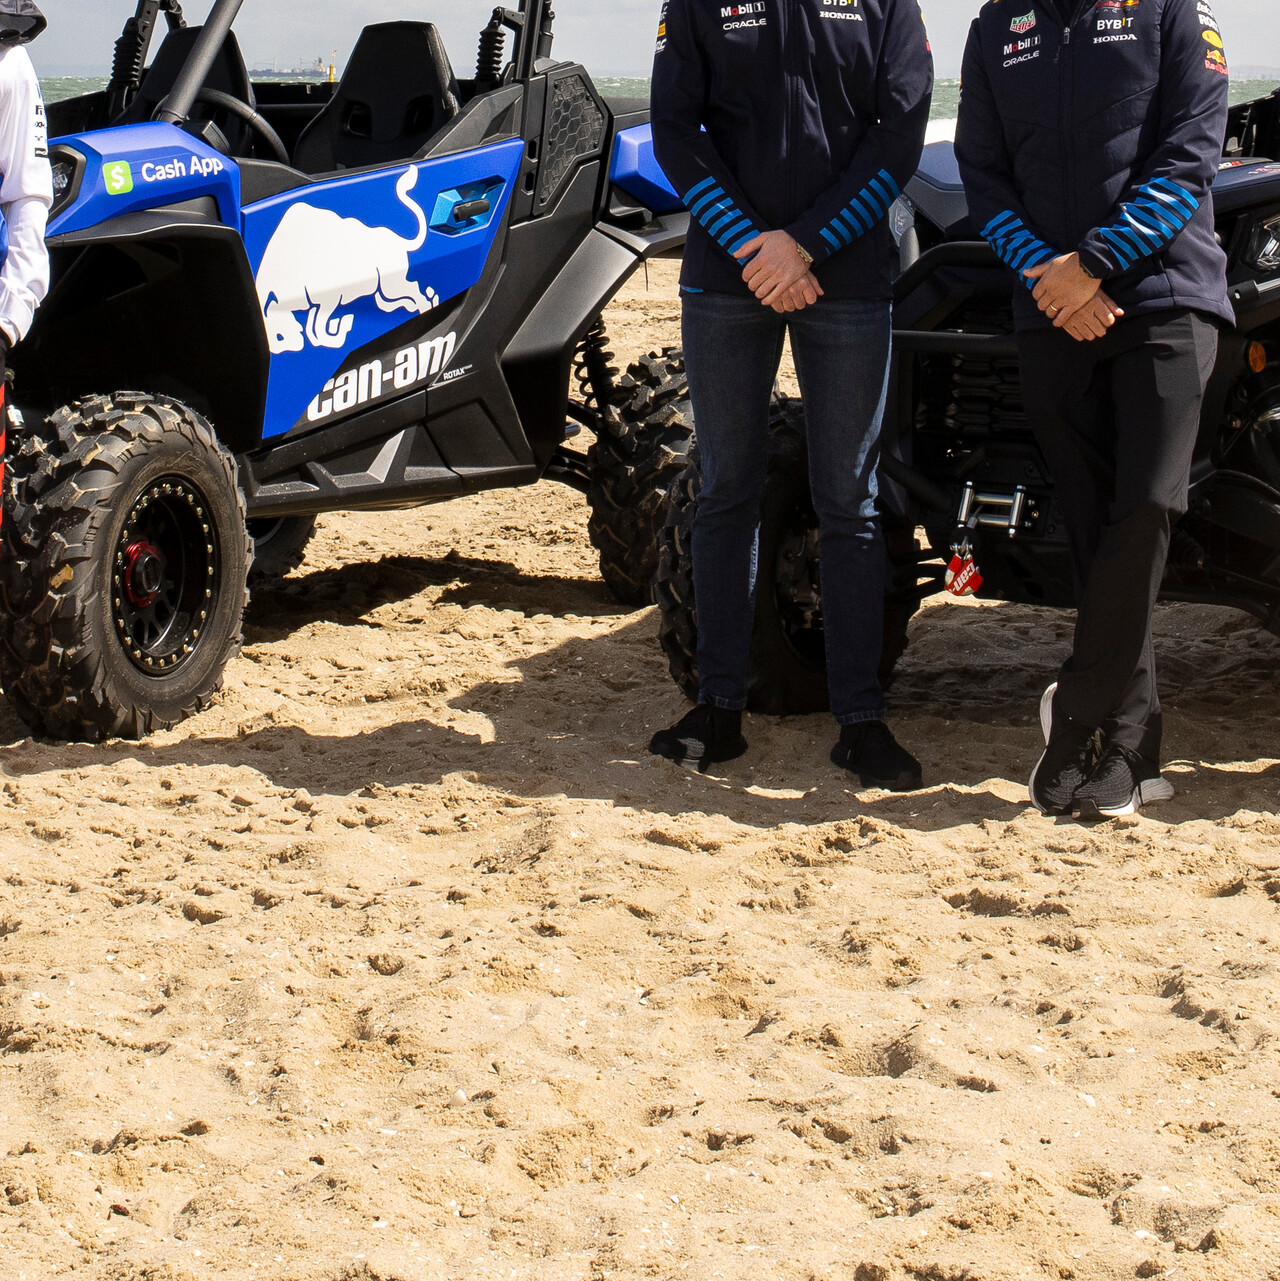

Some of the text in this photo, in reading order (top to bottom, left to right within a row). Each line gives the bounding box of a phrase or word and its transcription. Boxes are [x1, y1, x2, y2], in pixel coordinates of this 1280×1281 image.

[721, 3, 753, 18] Mobil
[819, 10, 863, 21] HONDA
[723, 18, 767, 30] ORACLE
[1096, 17, 1134, 31] BYBIT
[1093, 33, 1138, 44] HONDA
[1003, 38, 1031, 55] Mobil
[1003, 50, 1040, 67] ORACLE
[141, 158, 186, 182] Cash
[190, 155, 224, 177] App
[443, 368, 466, 380] ROTAX
